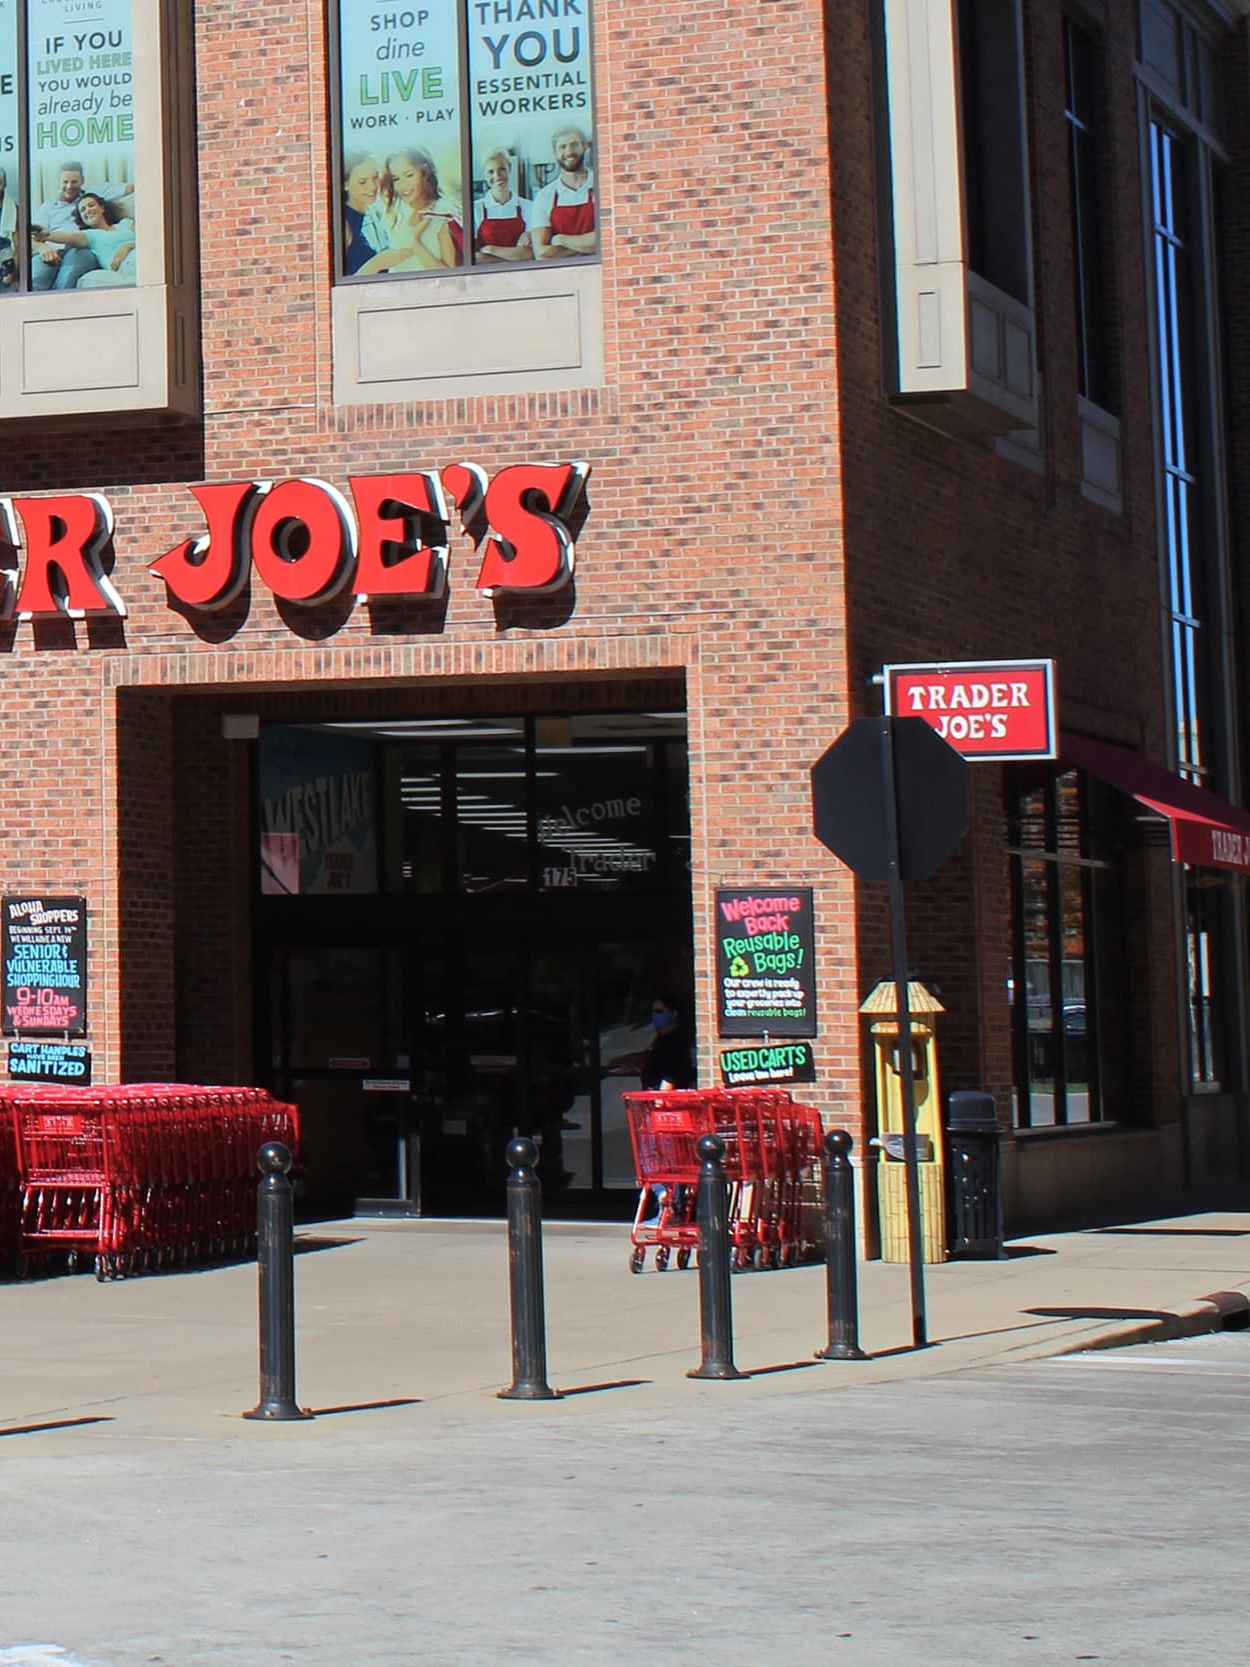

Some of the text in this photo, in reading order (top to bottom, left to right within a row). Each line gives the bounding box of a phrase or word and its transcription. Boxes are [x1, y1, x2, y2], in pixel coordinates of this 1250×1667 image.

[64, 1, 102, 13] LIVING
[474, 0, 582, 25] THANK
[370, 10, 429, 31] SHOP
[46, 30, 123, 55] IF YOU
[376, 38, 425, 60] dine
[482, 27, 580, 70] YOU
[37, 51, 132, 75] LIVED HERE
[38, 72, 132, 93] YOU WOULD
[359, 66, 443, 106] LIVE
[476, 71, 587, 95] ESSENTIAL
[37, 89, 133, 116] already be
[479, 92, 587, 117] WORKERS
[350, 108, 455, 129] WORK PLAY
[37, 113, 134, 149] HOME
[146, 462, 588, 610] JOE'S
[907, 682, 1031, 711] TRADER
[933, 713, 1009, 740] JOE'S
[8, 900, 44, 920] ALOHA
[29, 909, 79, 926] SHOPPERS
[721, 897, 801, 922] Welcome
[744, 914, 790, 936] Back
[14, 944, 61, 959] SENIOR
[723, 932, 800, 958] Reusable
[6, 959, 78, 974] VULNERABLE
[754, 949, 805, 975] Bags!
[7, 973, 55, 986] SHOPPING
[6, 1006, 78, 1017] WEDNESDAYS
[10, 1043, 86, 1058] CART HANDLES
[720, 1045, 806, 1072] USED CARTS
[9, 1058, 85, 1076] SANITIZED
